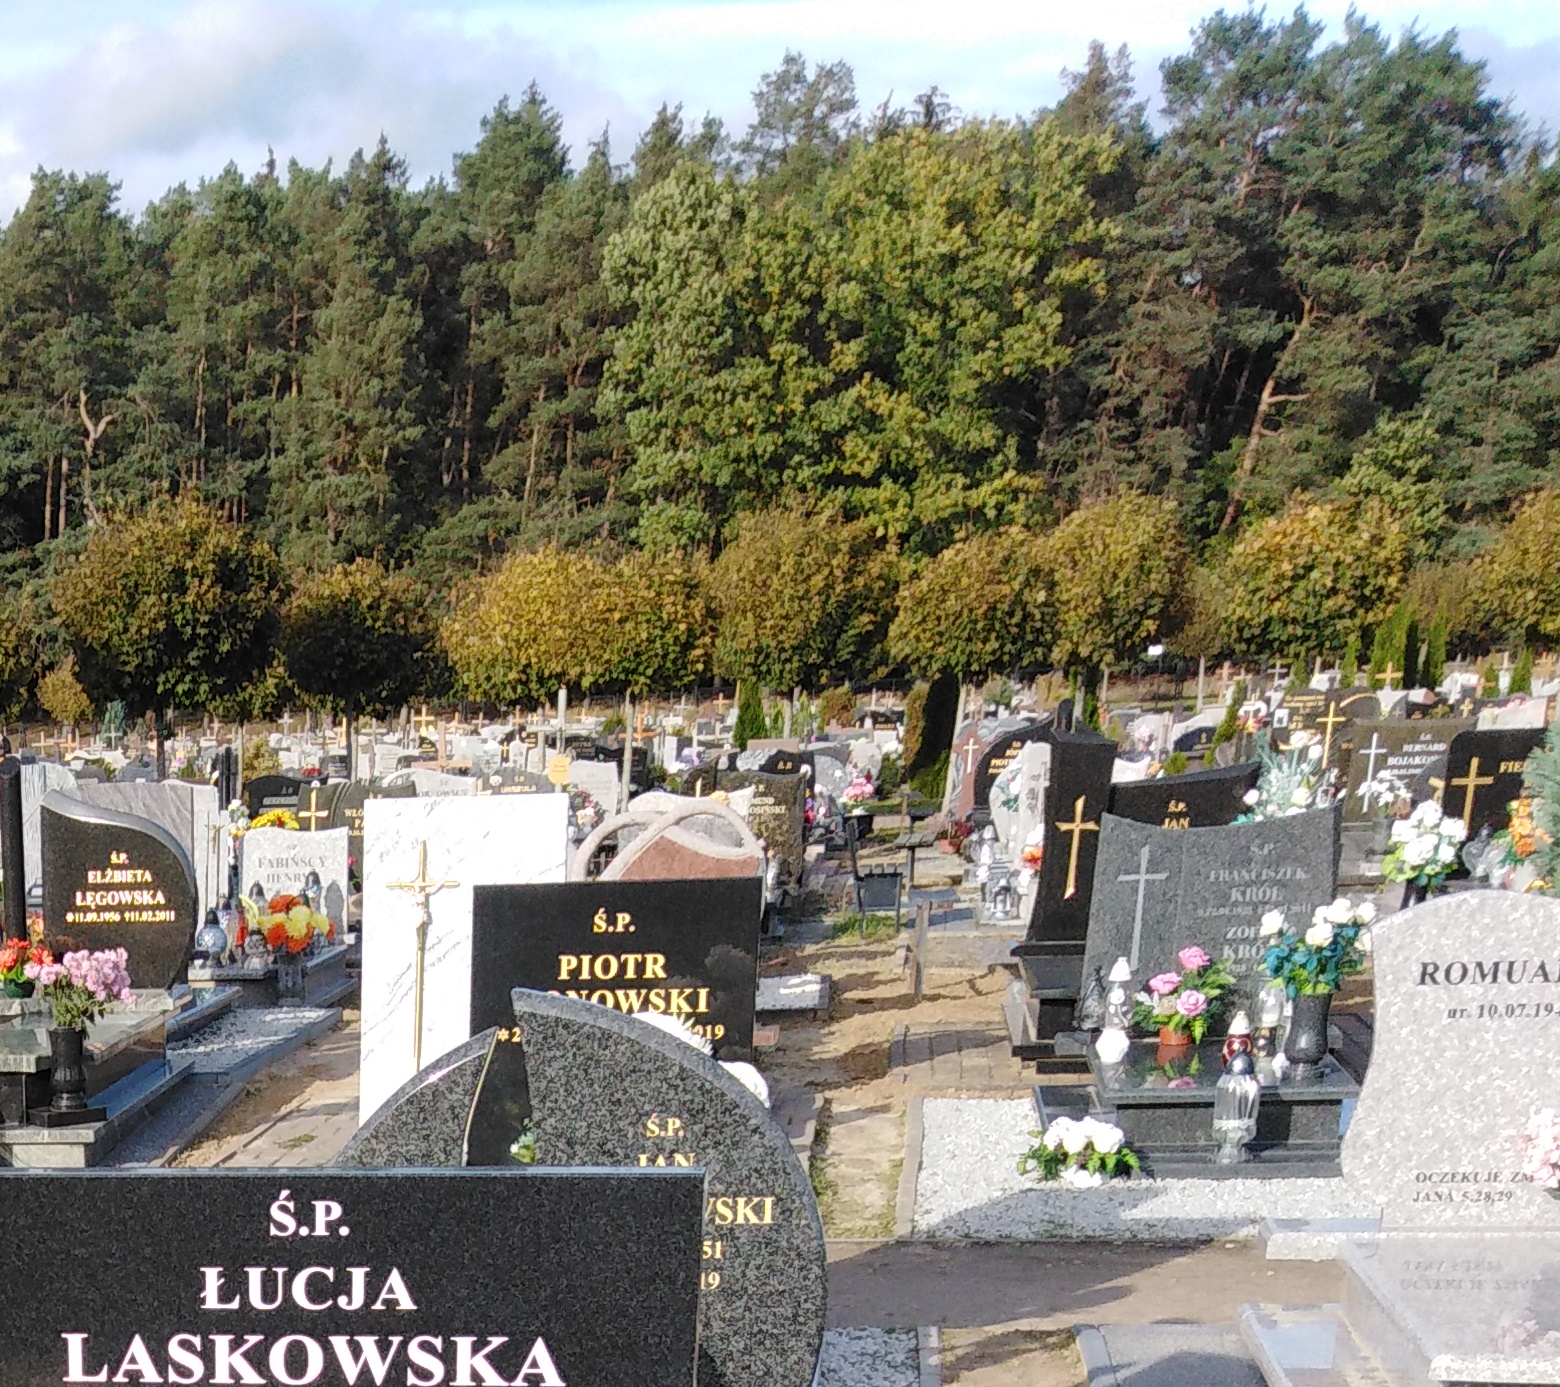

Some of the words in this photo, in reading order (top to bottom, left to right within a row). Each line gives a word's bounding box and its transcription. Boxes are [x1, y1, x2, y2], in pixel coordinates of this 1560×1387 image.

[87, 868, 152, 884] ELŻBIETA
[75, 889, 166, 909] ŁĘGOWSKA
[593, 907, 637, 933] Ś.P.
[1223, 942, 1265, 959] KRÓ
[557, 953, 668, 980] PIOTR
[1416, 959, 1560, 987] ROMUA
[646, 1112, 684, 1137] Ś.P.
[1415, 1171, 1503, 1184] OCZEKUJE
[1412, 1190, 1455, 1203] JANA
[269, 1189, 351, 1237] Ś.P.
[199, 1266, 419, 1311] ŁUCJA
